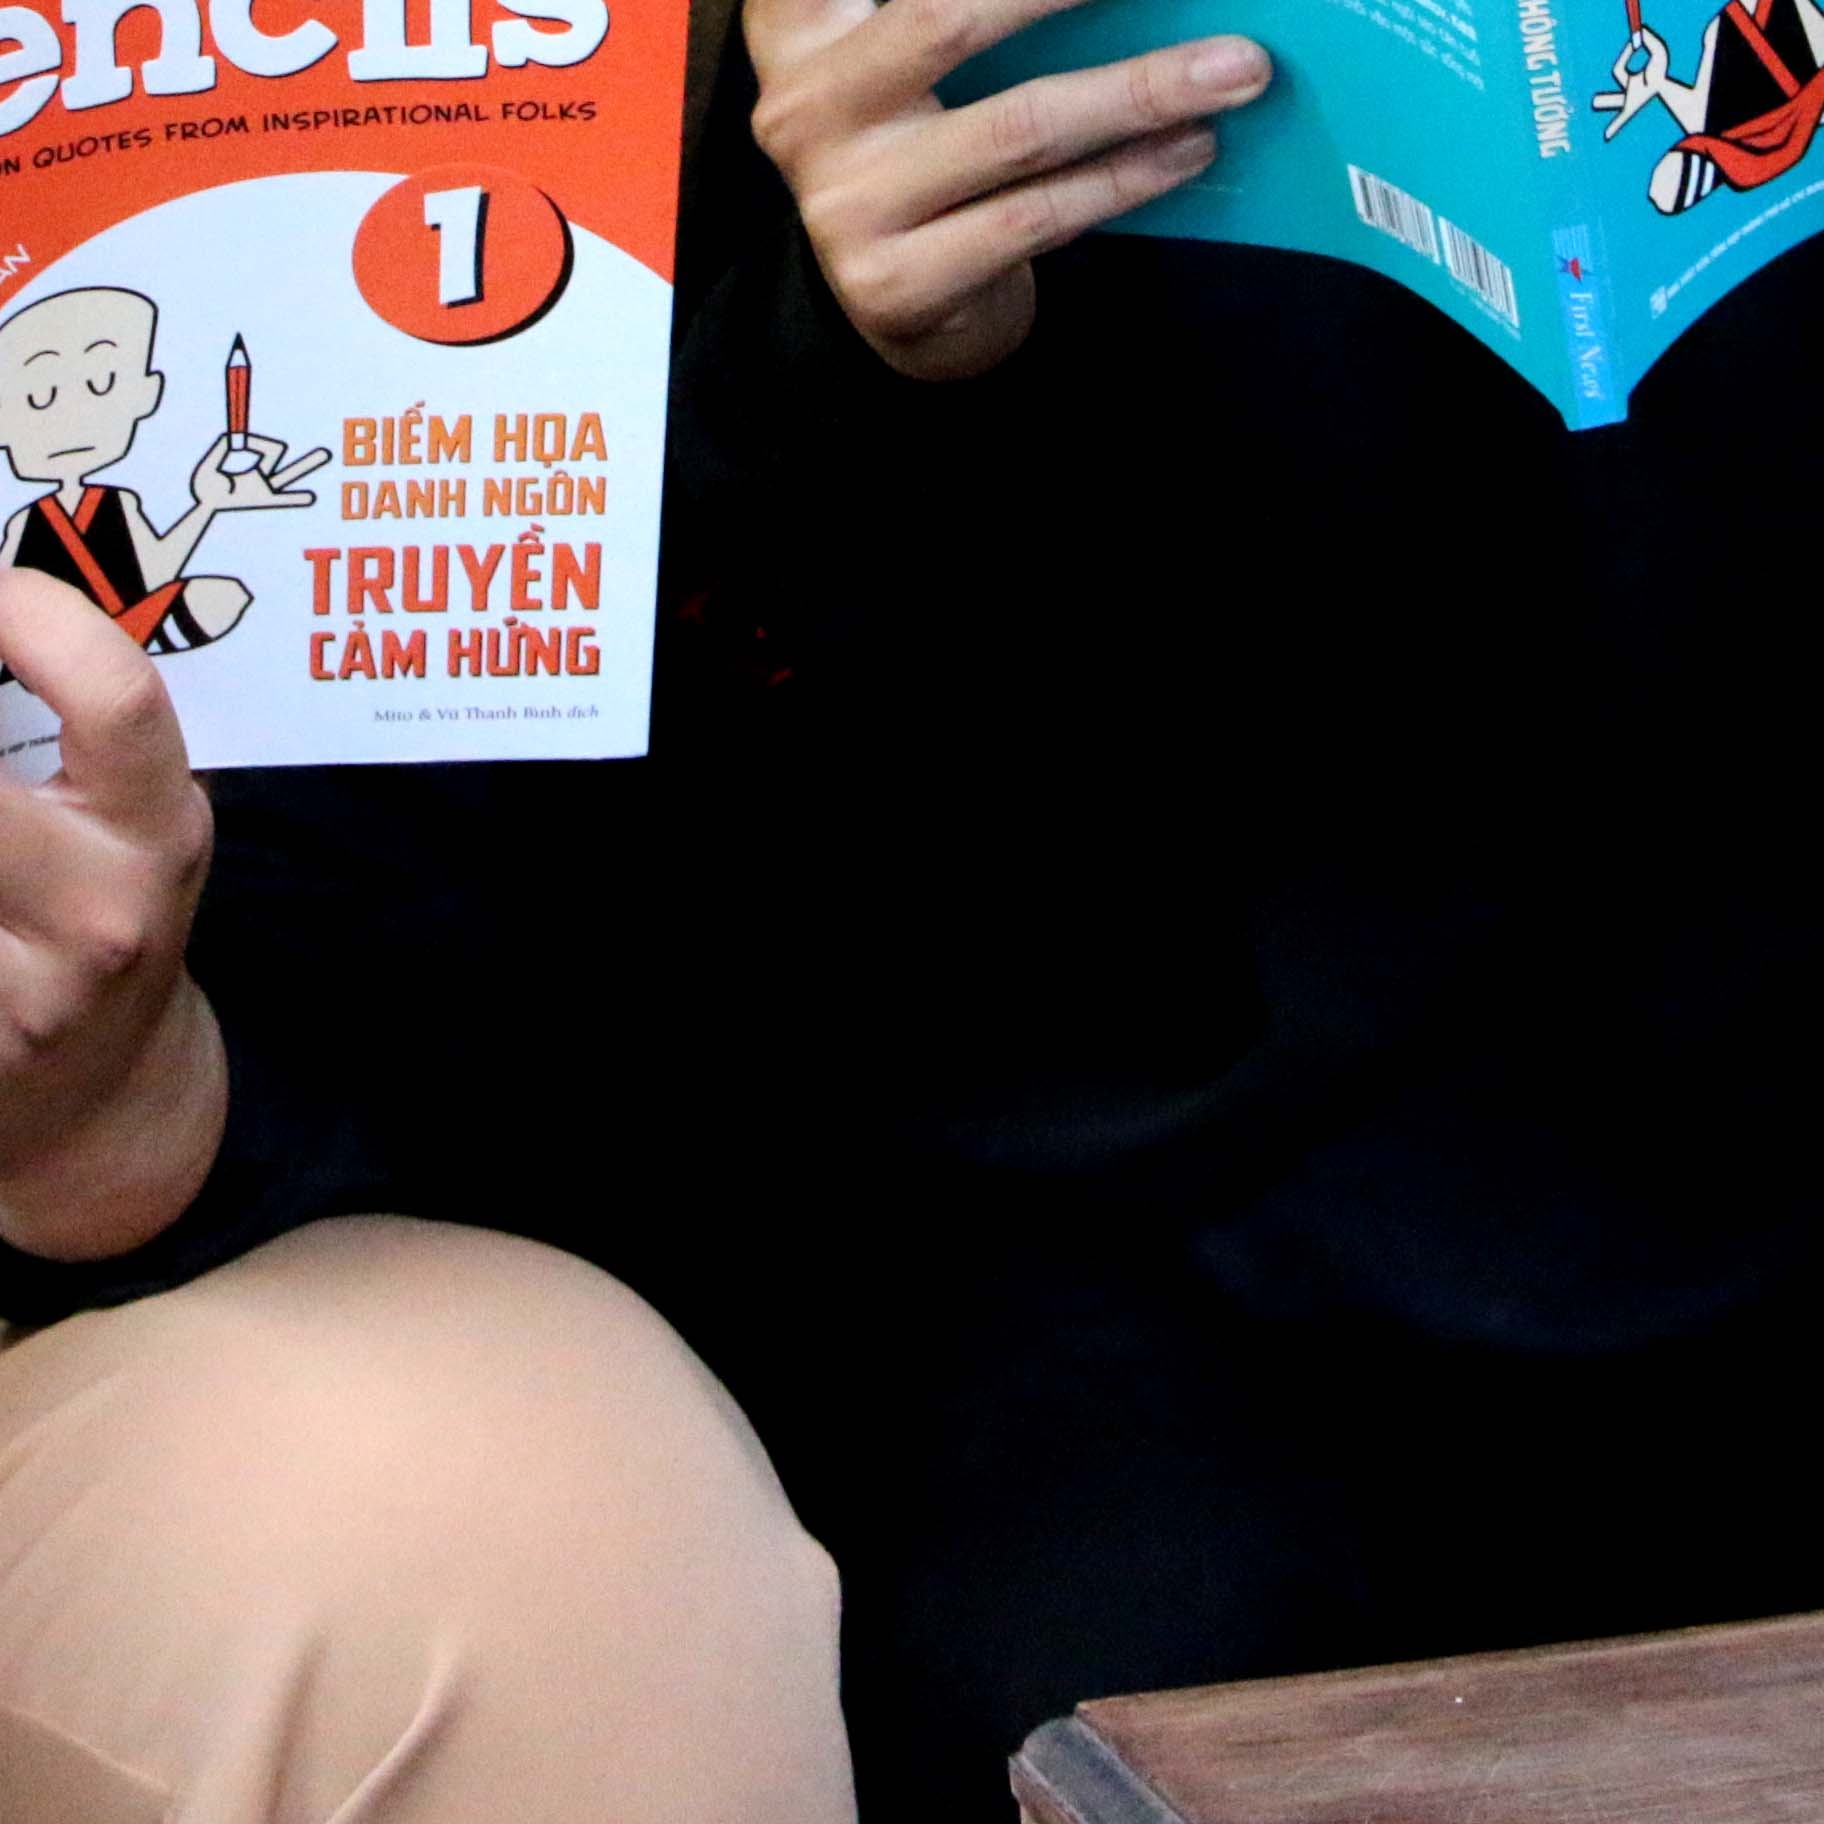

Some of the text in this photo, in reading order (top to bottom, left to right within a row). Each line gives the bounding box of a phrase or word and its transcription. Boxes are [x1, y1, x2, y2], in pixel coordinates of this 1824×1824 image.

[31, 129, 153, 170] QUOTES
[165, 115, 250, 142] FROM
[261, 103, 489, 133] INSPIRATIONAL
[501, 100, 597, 122] FOLKS
[423, 184, 490, 310] 1
[342, 400, 608, 469] BIẾM HỌA
[341, 469, 607, 520] DANH NGÔN
[305, 523, 602, 615] TRUYỀN
[310, 616, 600, 681] CẢM HỨNG
